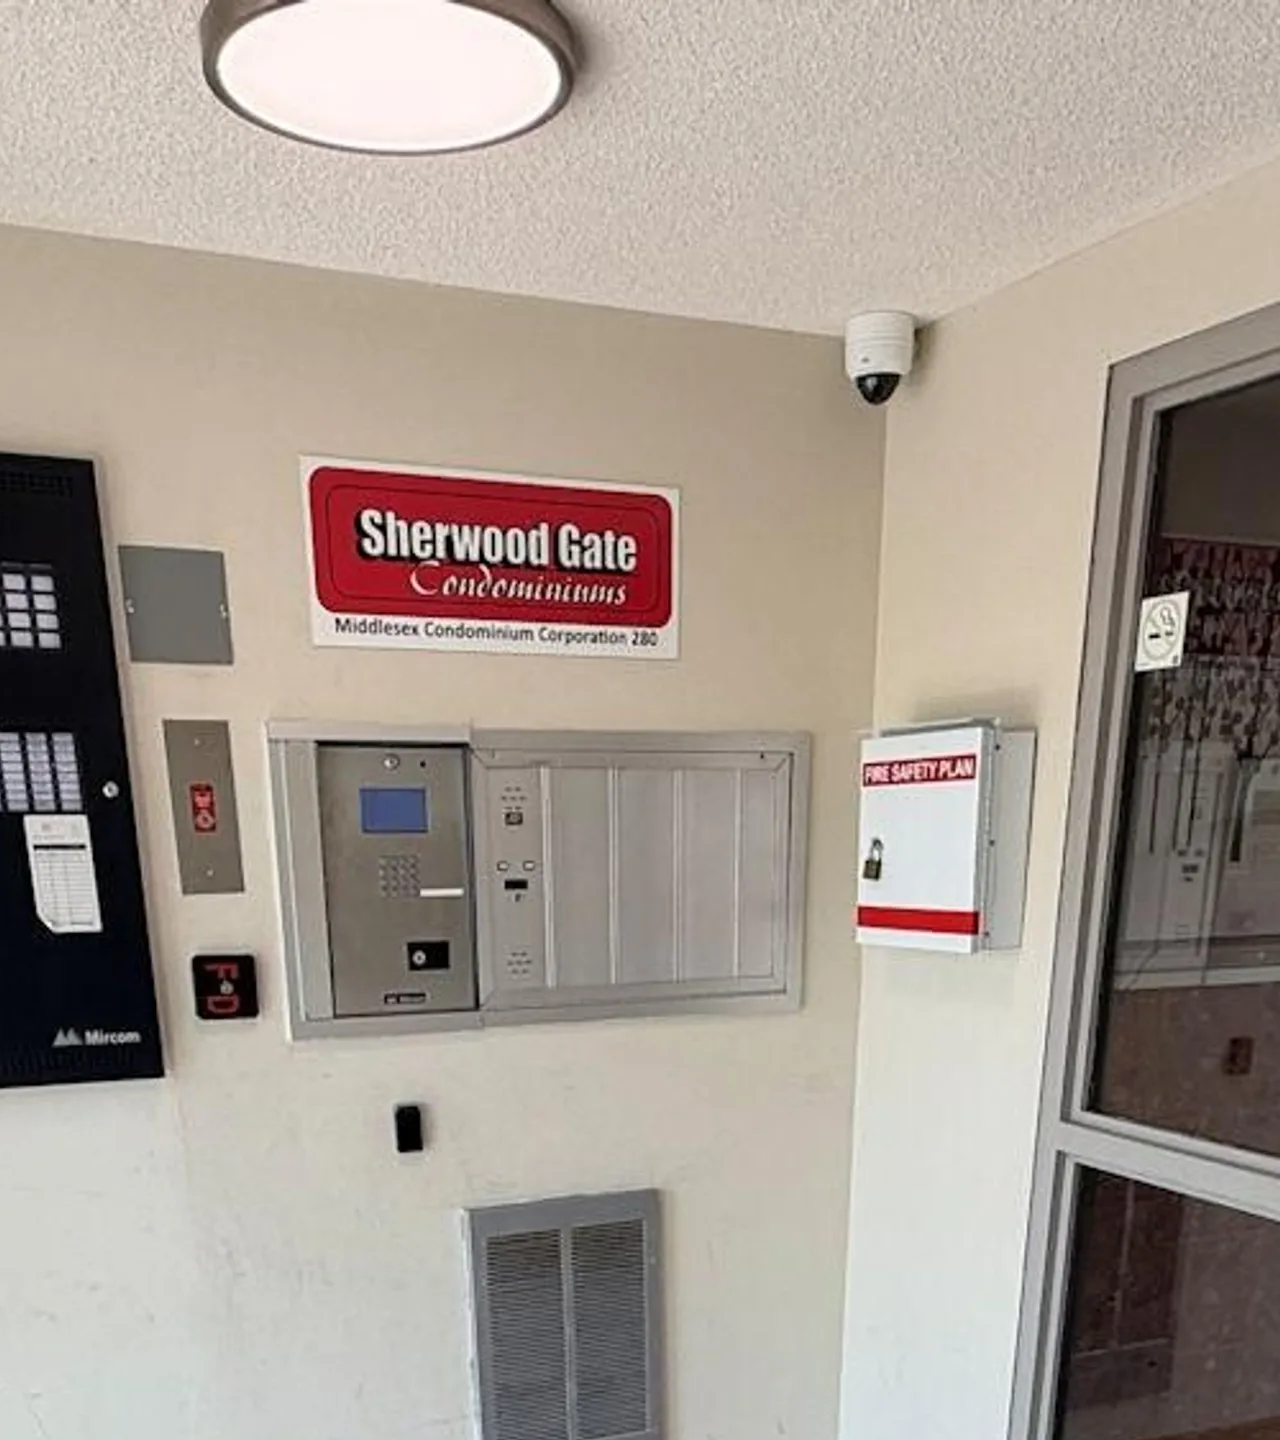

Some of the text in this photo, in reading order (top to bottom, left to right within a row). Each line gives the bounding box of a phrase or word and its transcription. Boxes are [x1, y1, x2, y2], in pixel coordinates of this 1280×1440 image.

[358, 508, 638, 571] Sherwood Gate
[410, 559, 626, 605] Condominiums
[335, 616, 658, 648] Middlesex Condominium Corporation 280
[865, 758, 974, 784] FIRE SAFETY PLAN
[84, 1028, 141, 1046] Mircom
